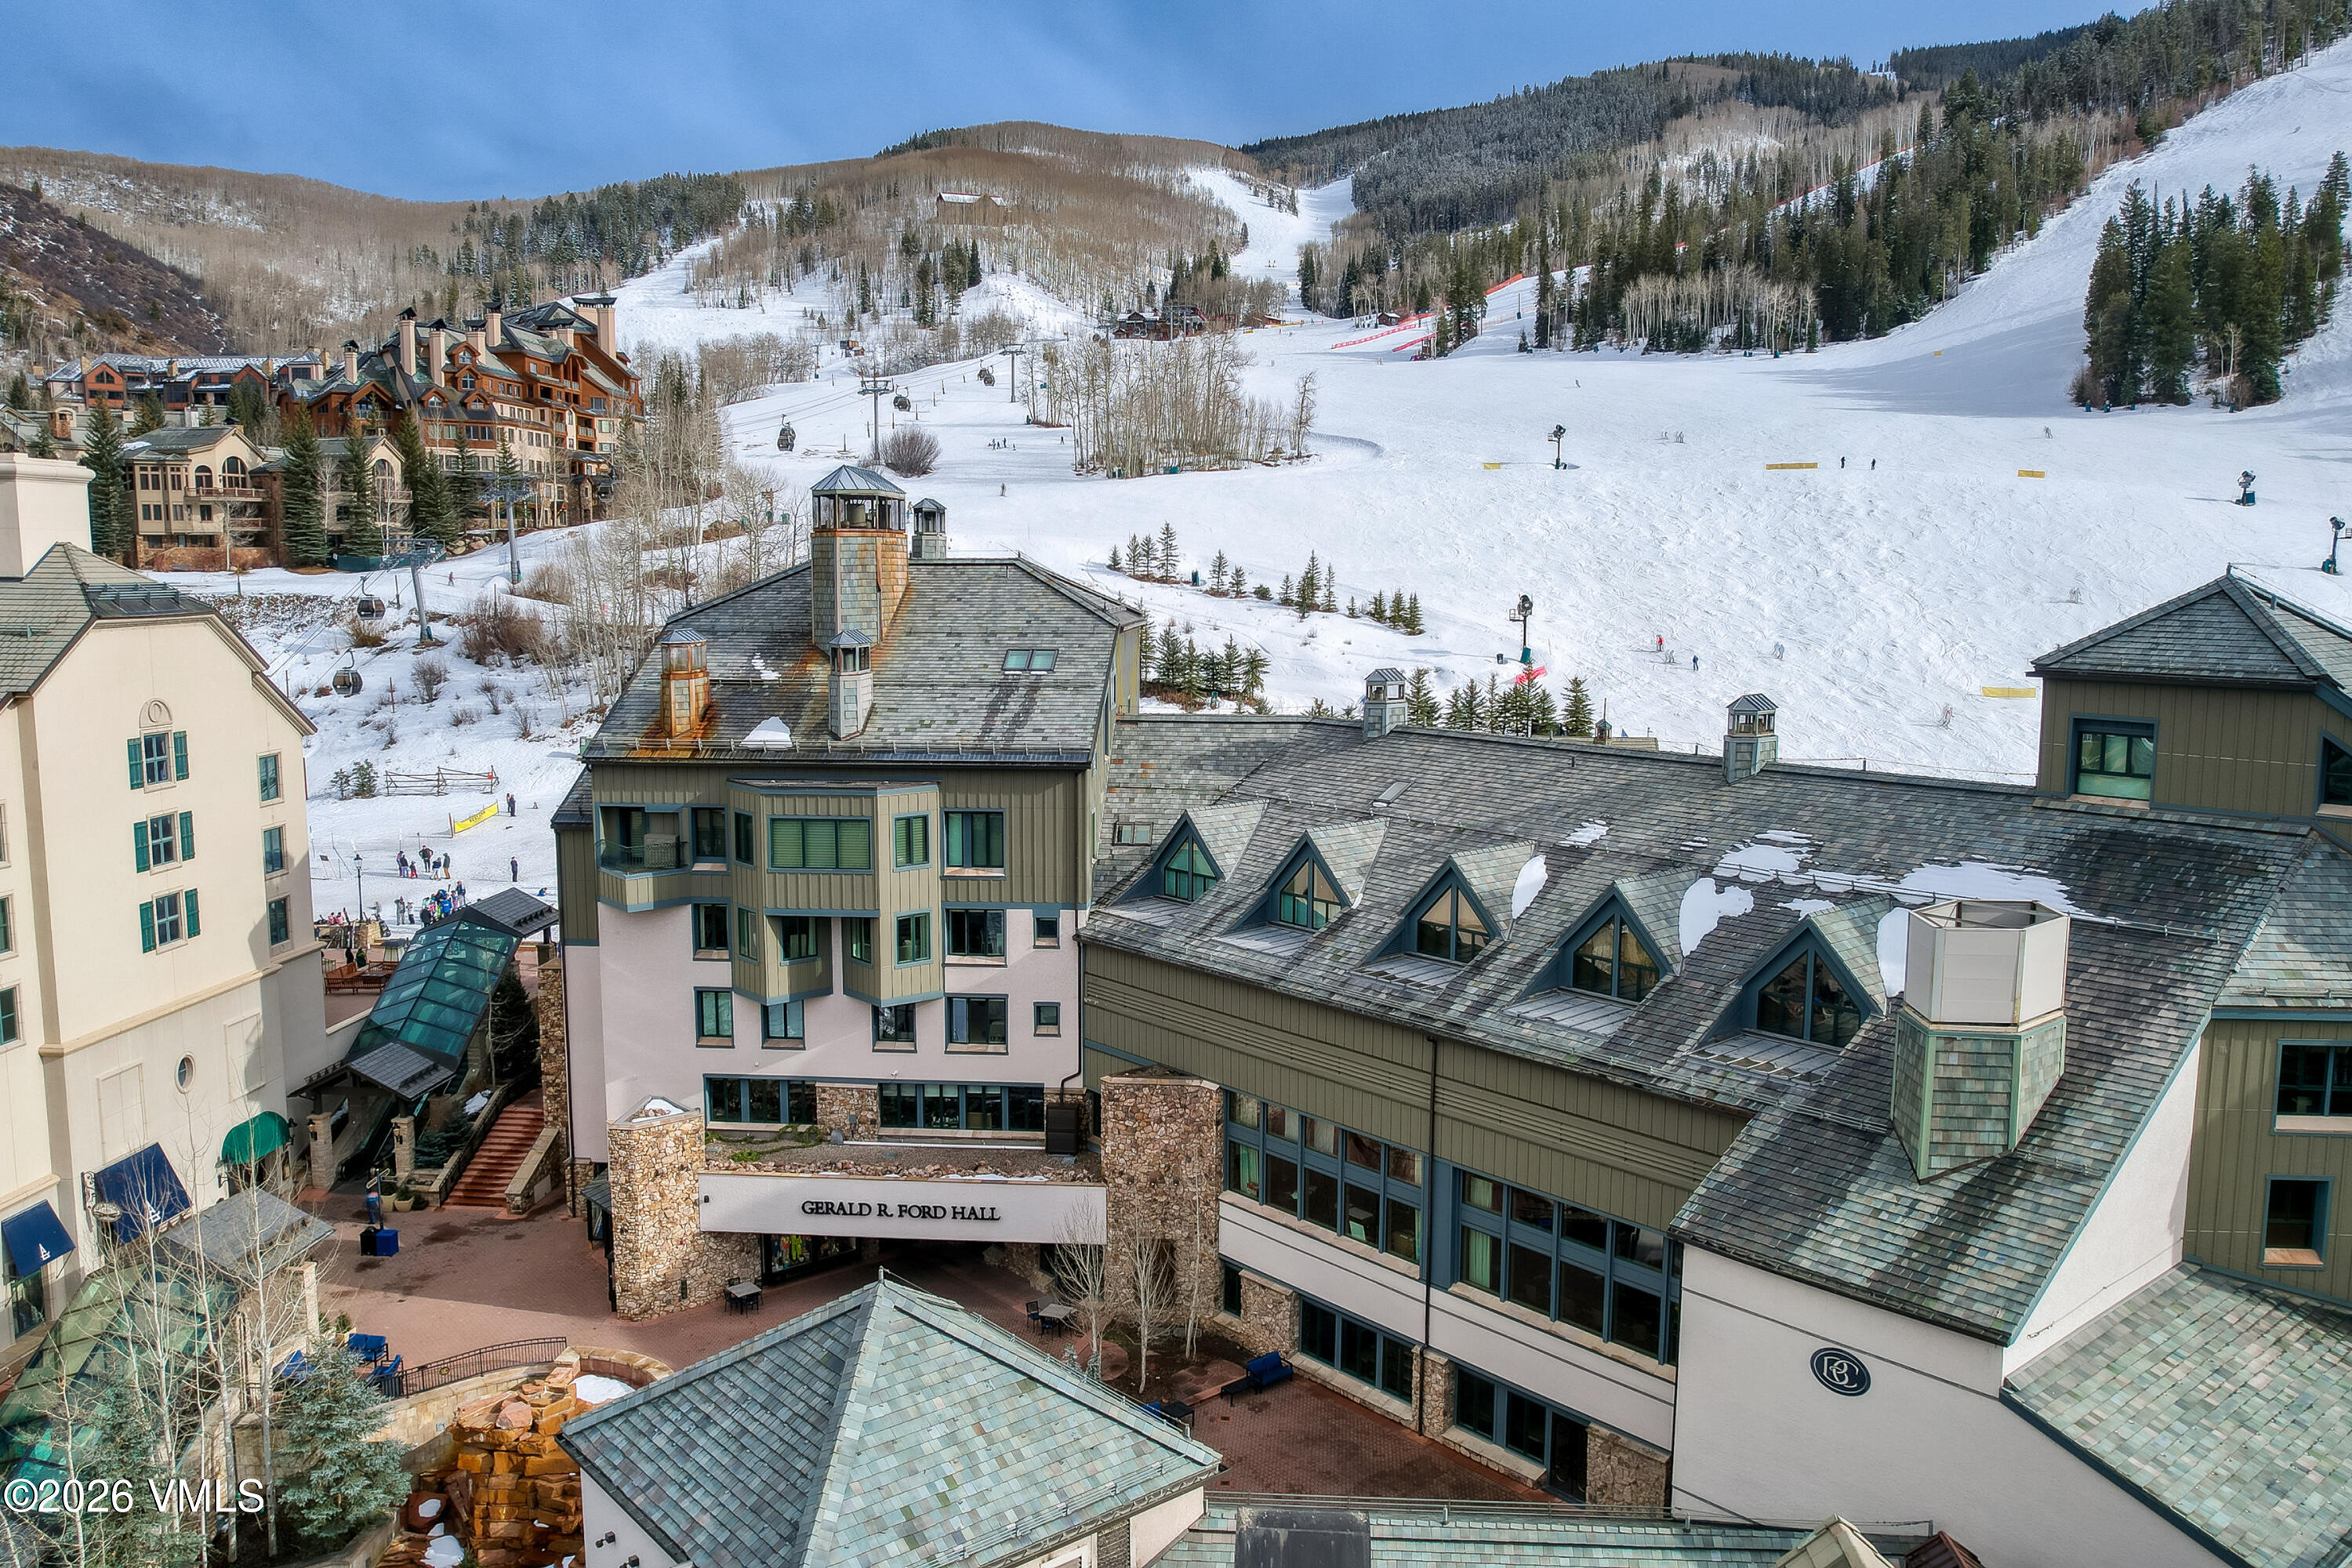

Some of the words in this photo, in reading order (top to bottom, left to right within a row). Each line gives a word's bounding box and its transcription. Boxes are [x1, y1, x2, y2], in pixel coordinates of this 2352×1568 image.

[800, 1200, 873, 1217] GERALD
[877, 1203, 894, 1218] R.
[897, 1203, 947, 1220] FORD
[951, 1206, 1001, 1221] HALL
